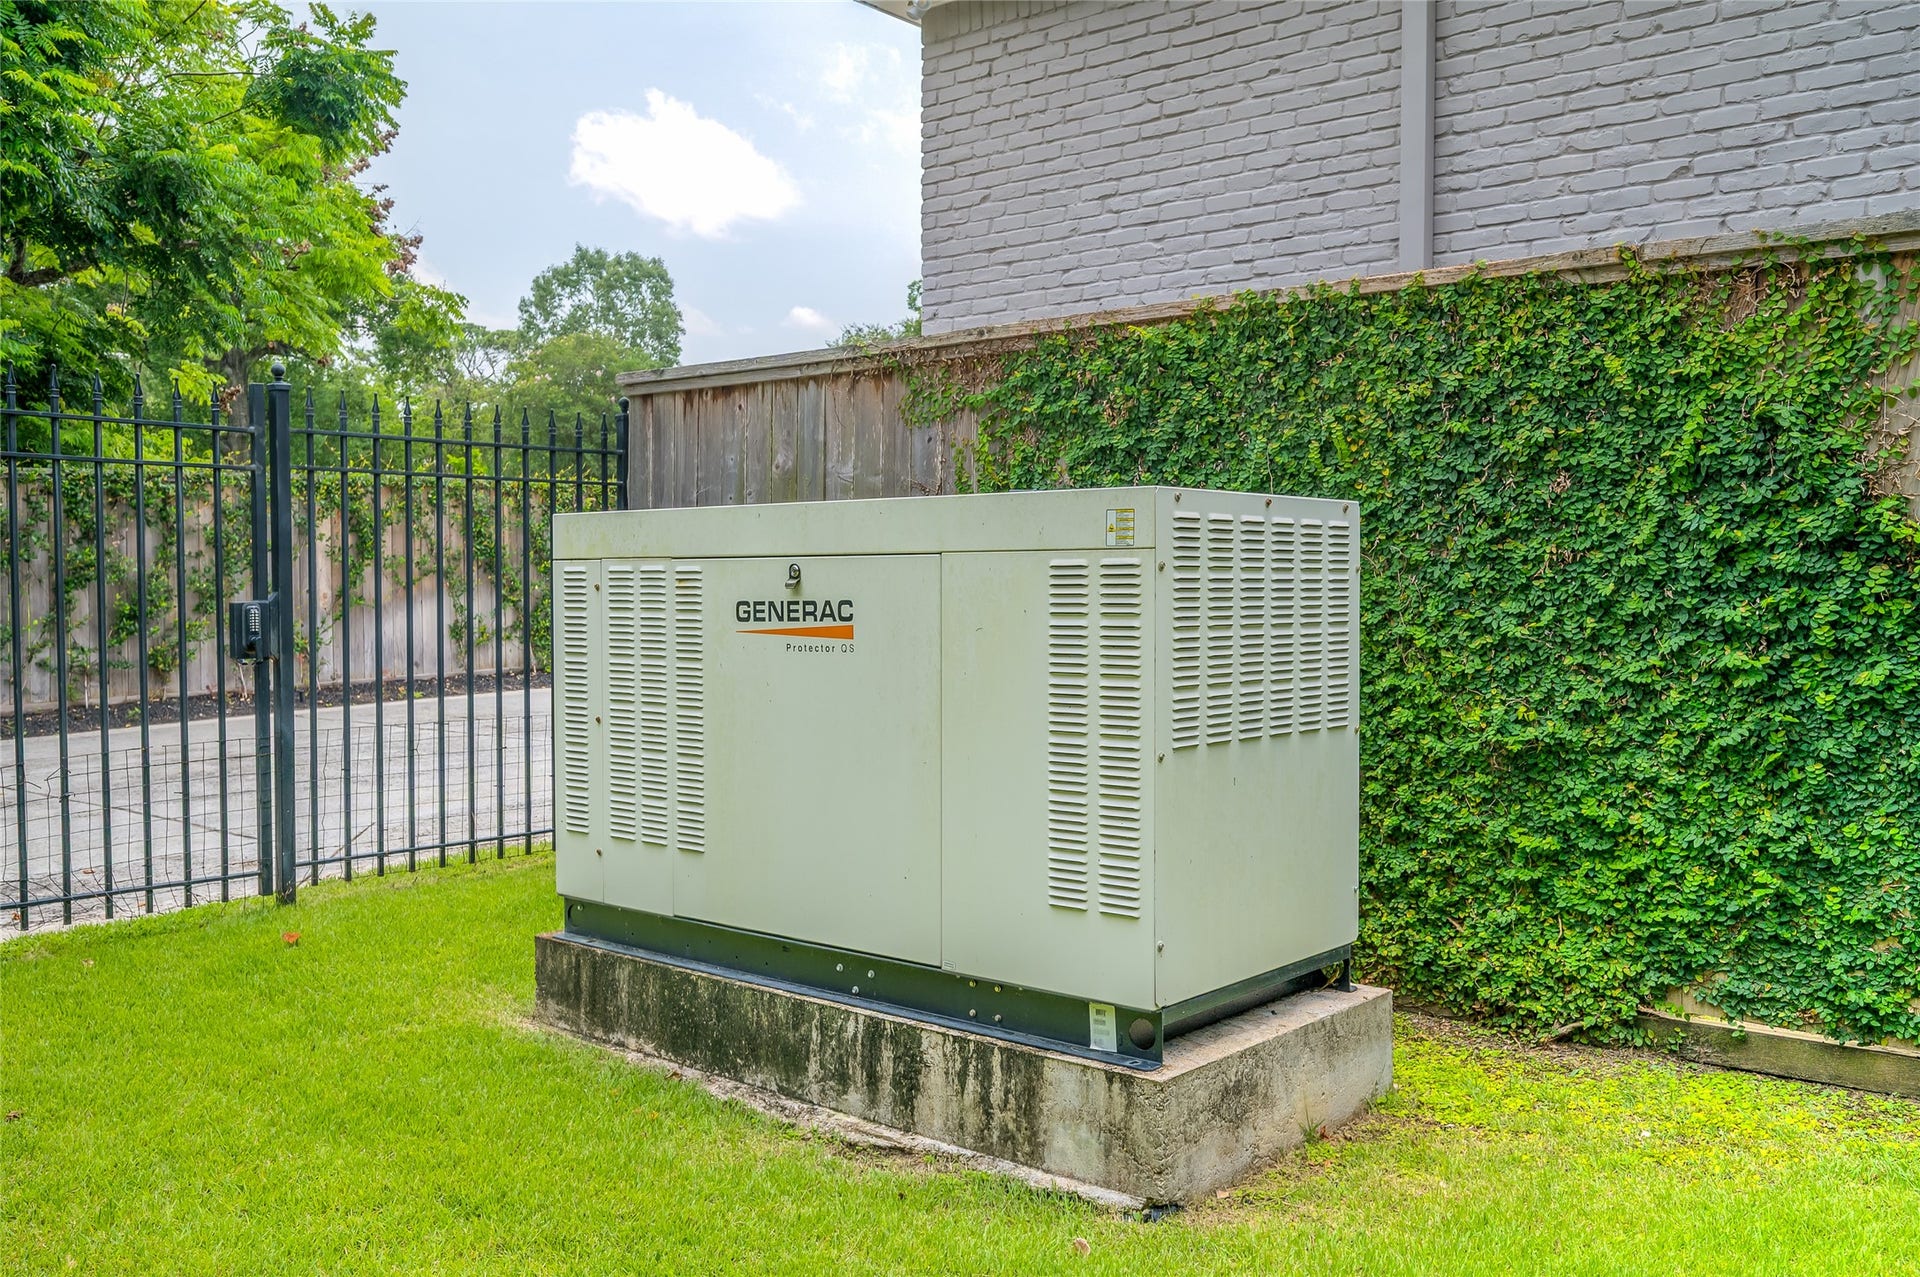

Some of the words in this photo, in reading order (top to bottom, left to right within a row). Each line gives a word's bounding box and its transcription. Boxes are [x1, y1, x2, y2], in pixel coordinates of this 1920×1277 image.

[735, 599, 854, 622] GENERAC
[786, 643, 836, 653] Protector
[840, 643, 855, 653] QS
